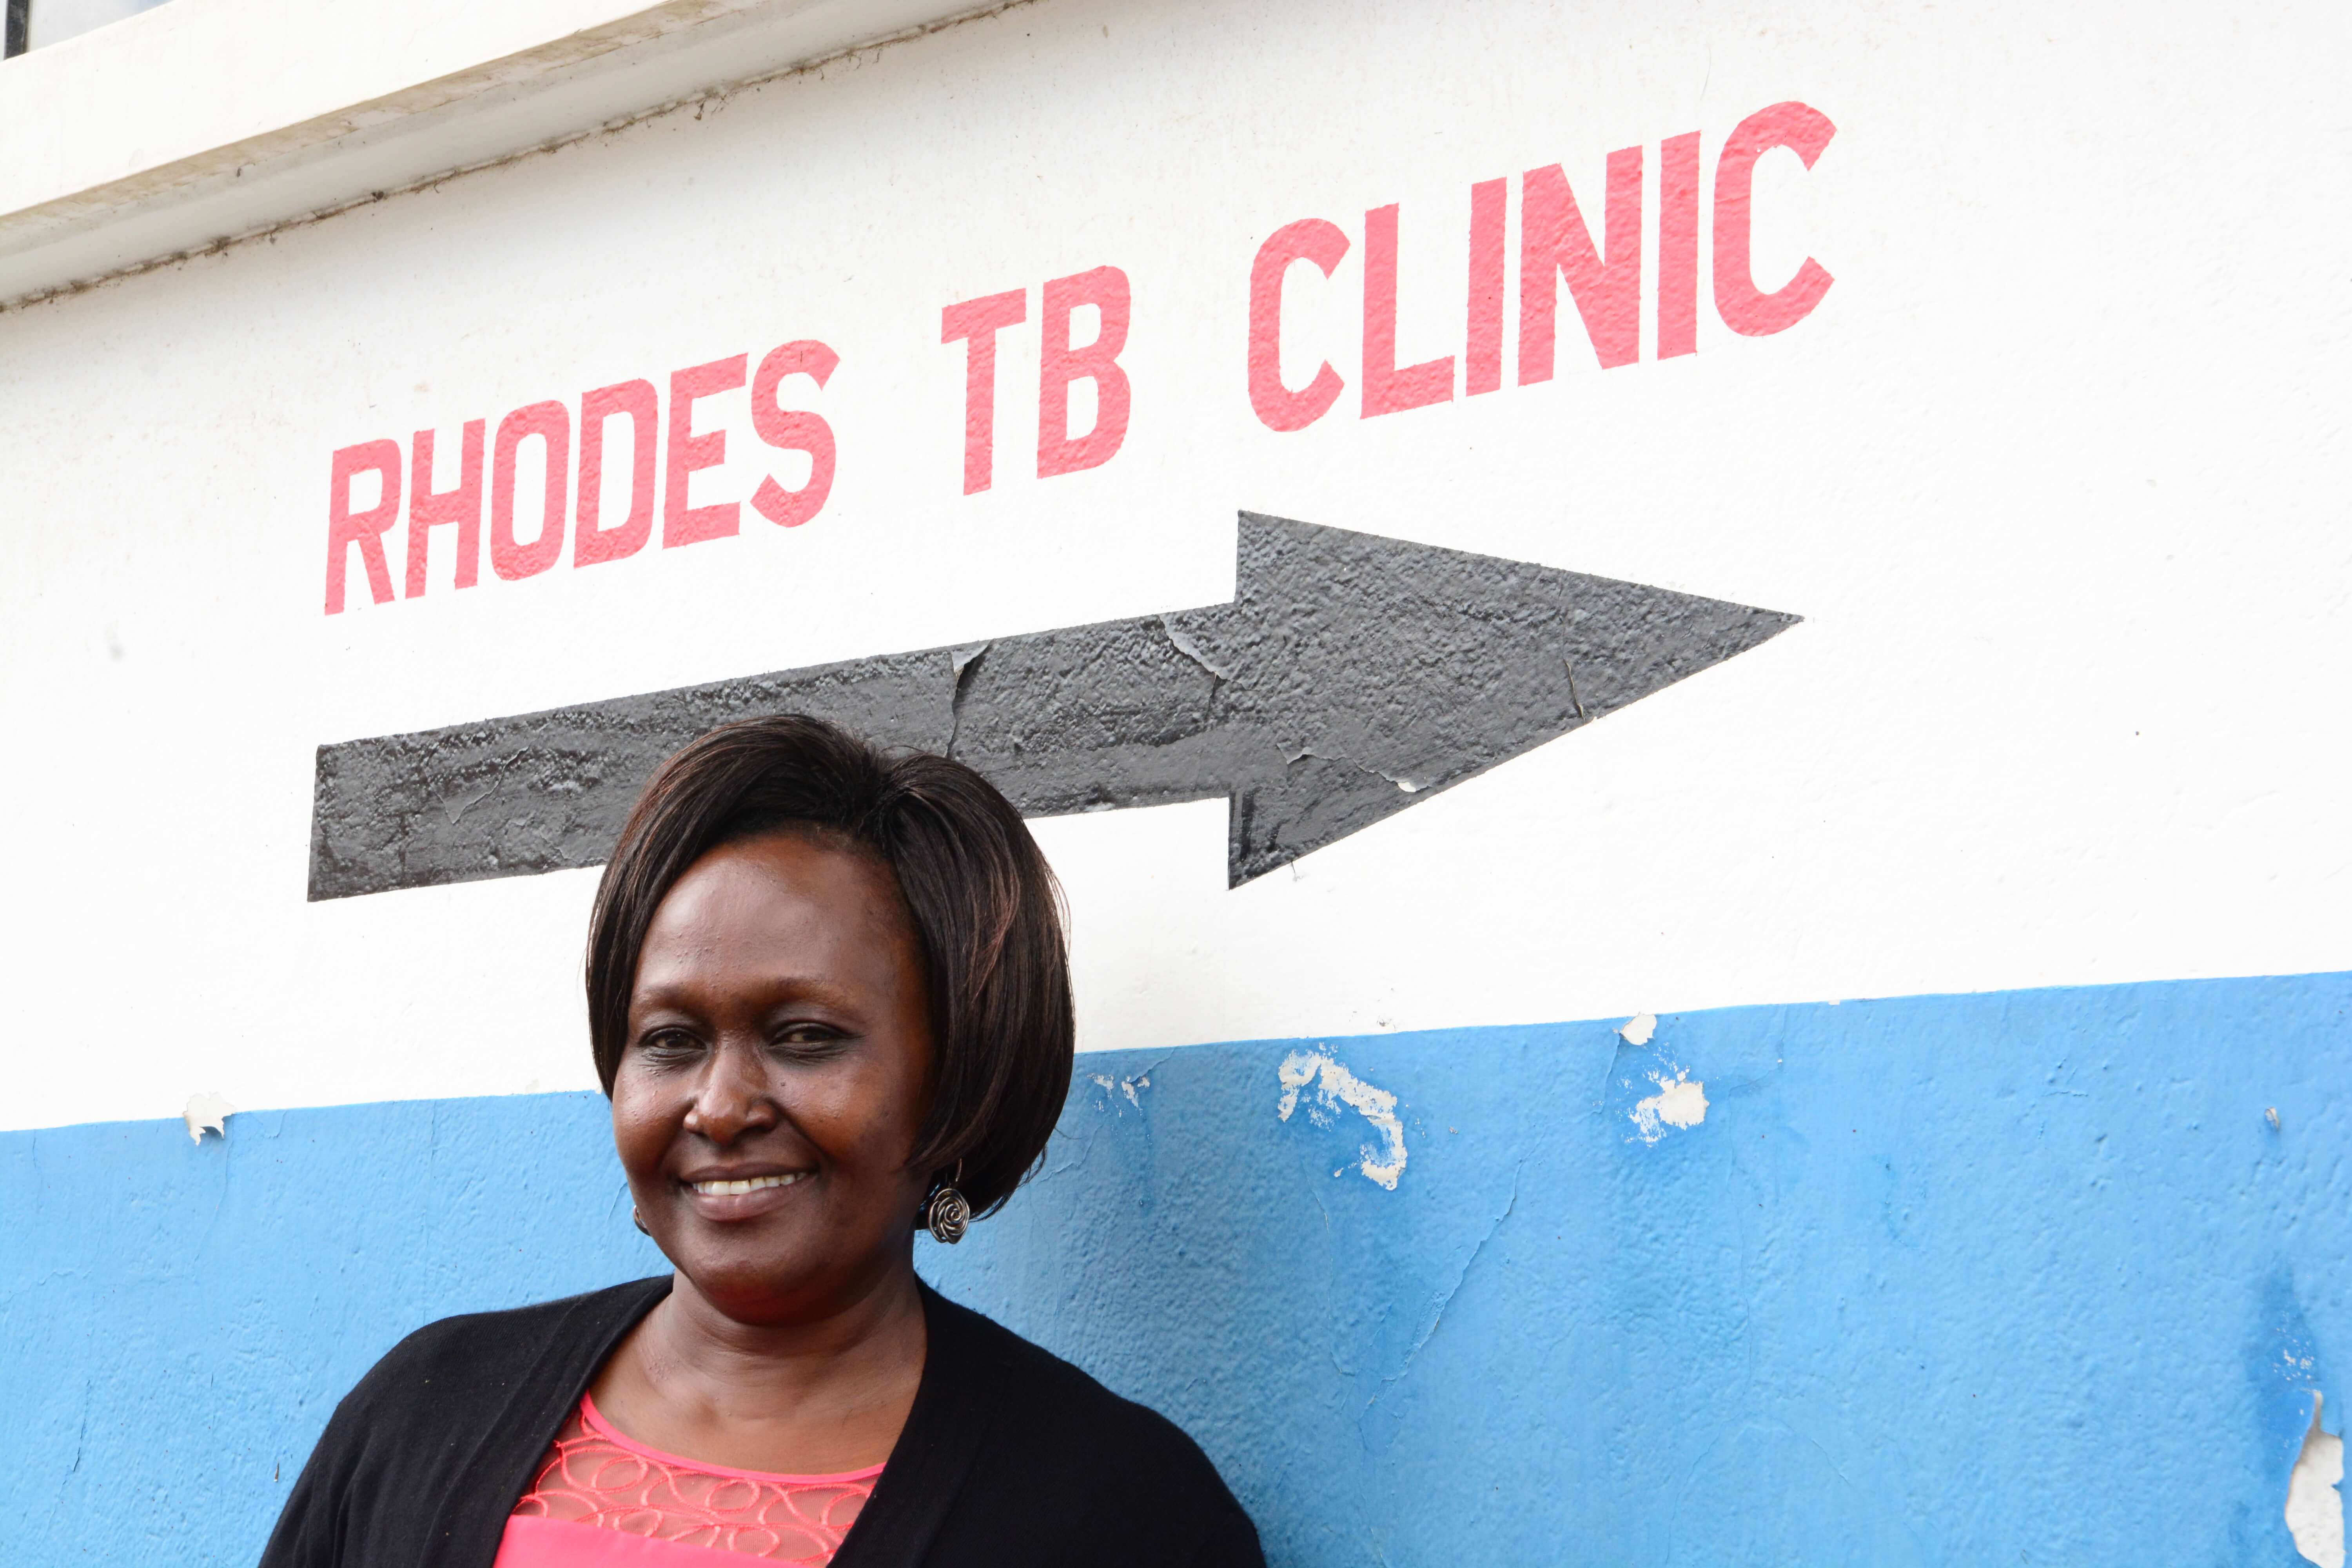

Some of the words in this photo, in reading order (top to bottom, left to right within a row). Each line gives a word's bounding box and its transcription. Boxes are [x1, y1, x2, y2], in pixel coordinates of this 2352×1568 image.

[325, 340, 840, 615] RHODES
[941, 265, 1131, 495] TB
[1248, 101, 1837, 432] CLINIC
